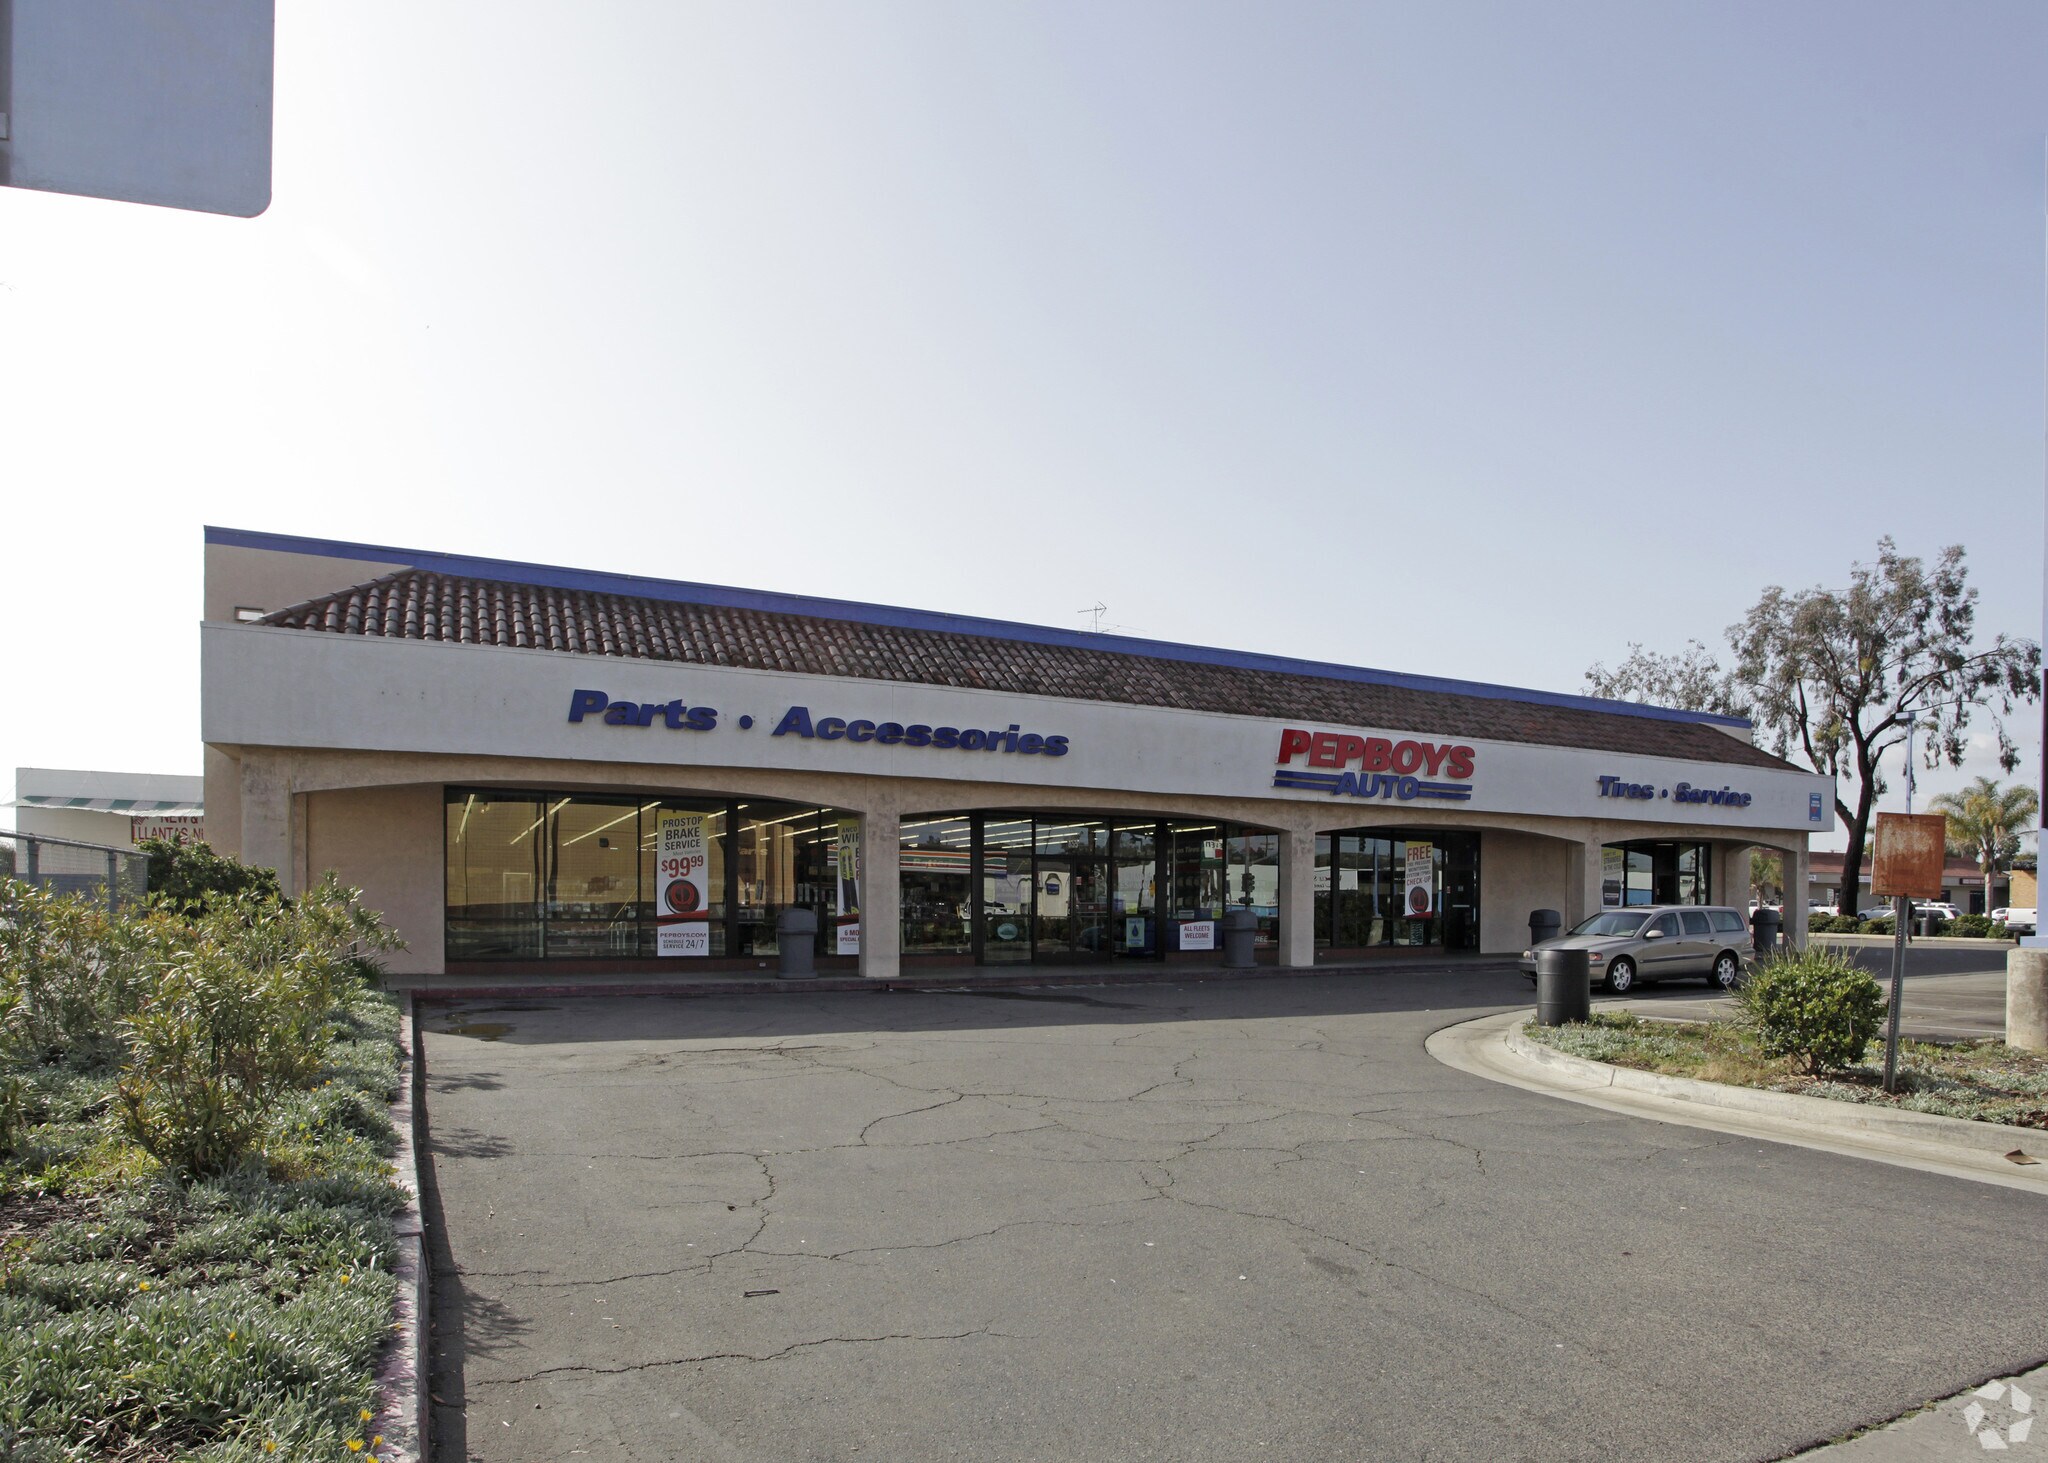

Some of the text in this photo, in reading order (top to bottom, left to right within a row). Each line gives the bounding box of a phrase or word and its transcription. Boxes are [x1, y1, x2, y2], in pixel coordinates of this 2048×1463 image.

[567, 689, 1070, 757] Parts Accessories
[1275, 728, 1476, 779] PEPBOYS
[1331, 771, 1421, 801] AUTO
[1597, 775, 1752, 807] Tires Service
[662, 816, 704, 829] PROSTOP
[138, 826, 189, 841] LLANTAS
[665, 826, 701, 841] BRAKE
[664, 838, 701, 851] SERVICE
[1407, 846, 1431, 861] FREE
[685, 939, 705, 949] 24/7
[1254, 935, 1268, 943] REE
